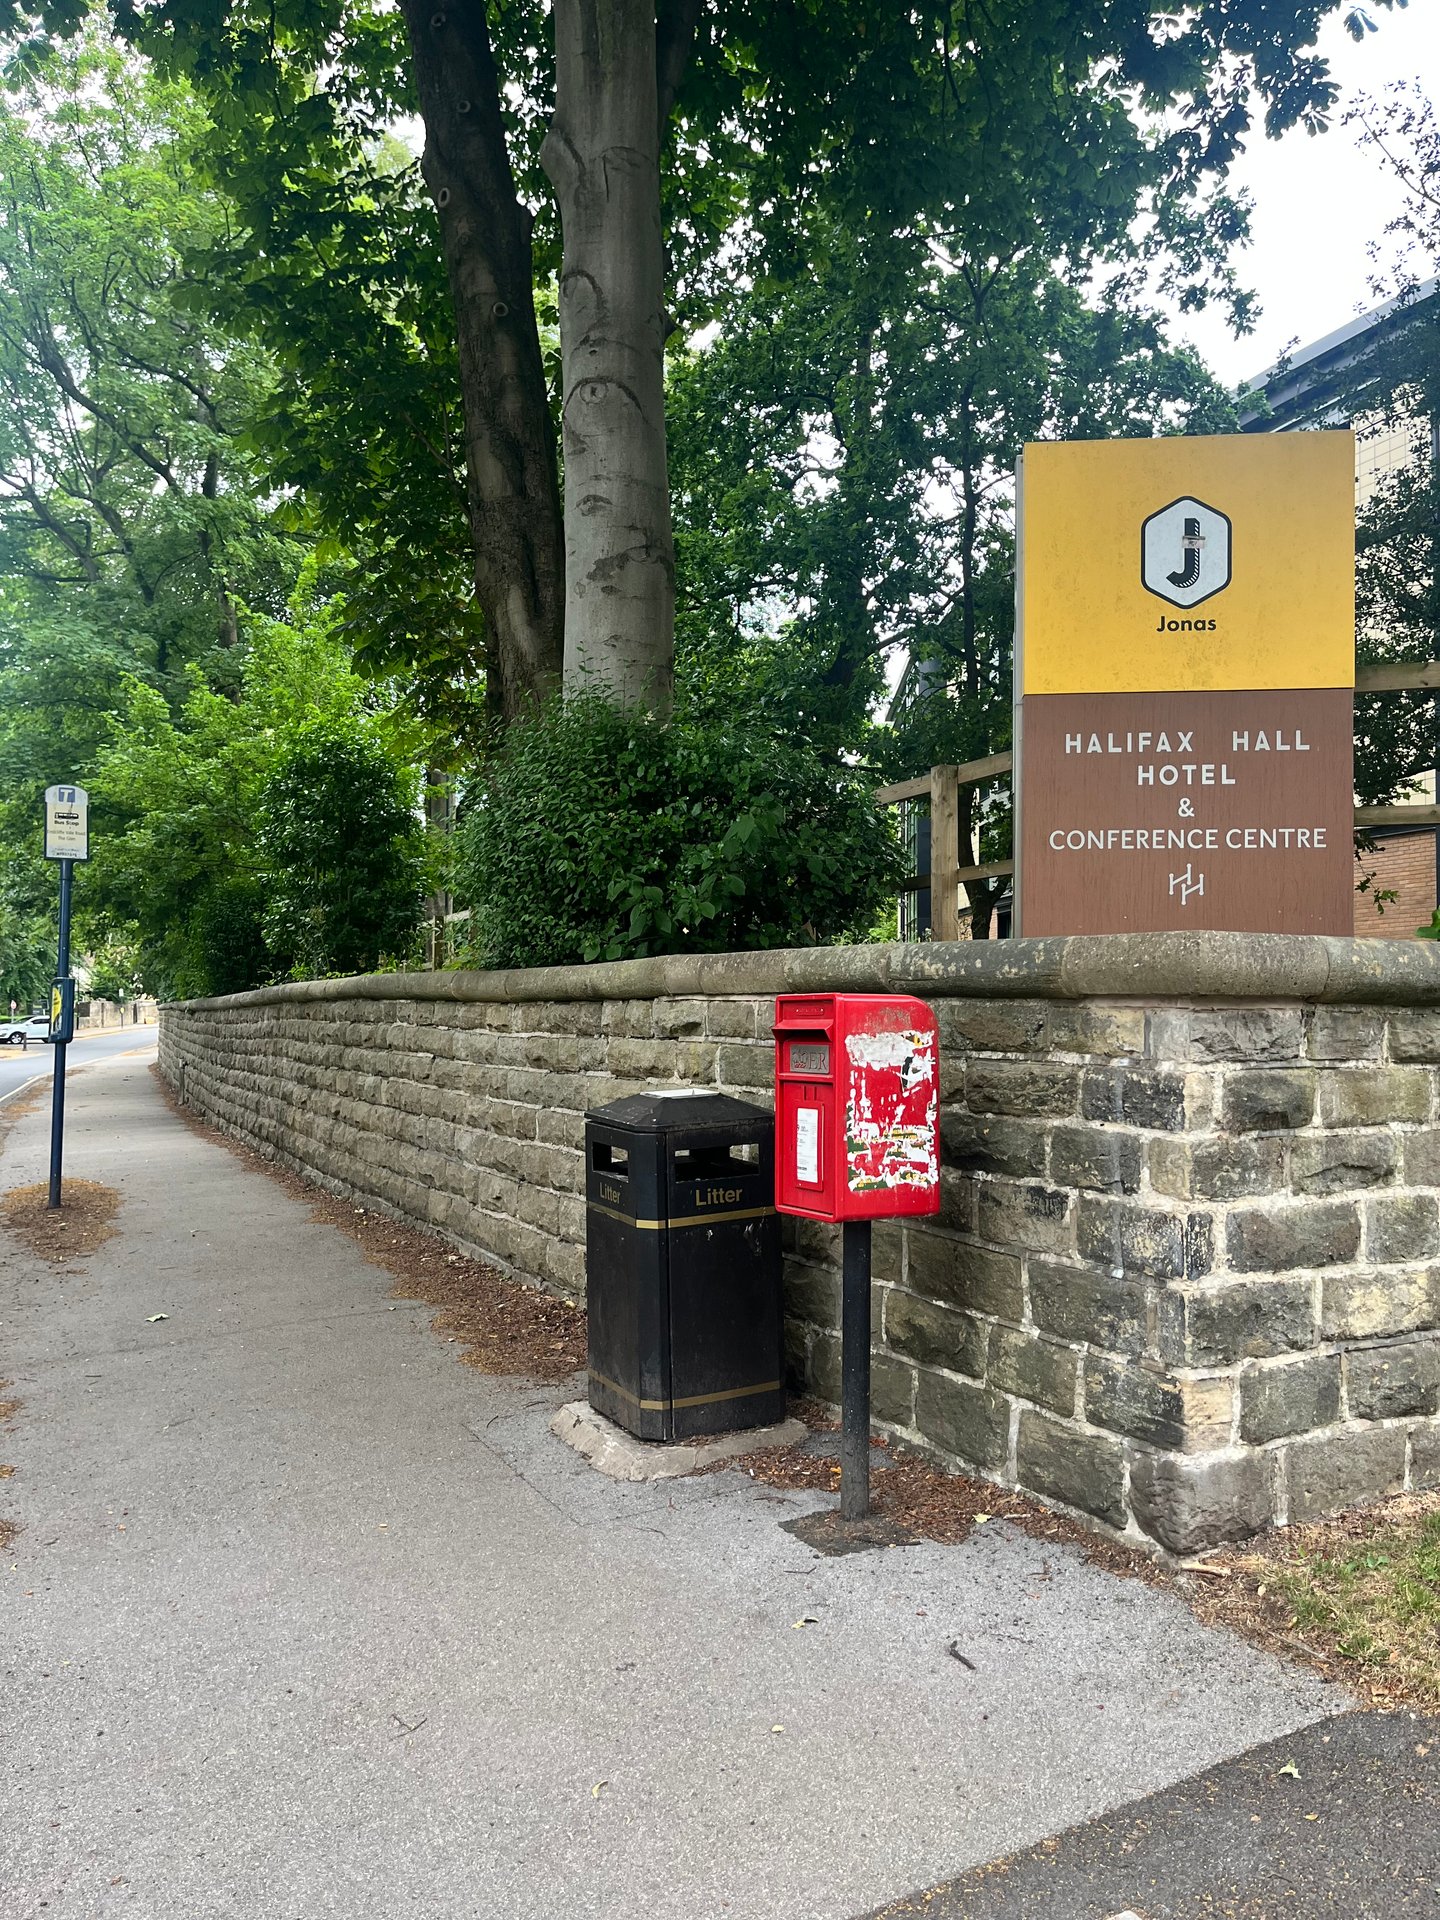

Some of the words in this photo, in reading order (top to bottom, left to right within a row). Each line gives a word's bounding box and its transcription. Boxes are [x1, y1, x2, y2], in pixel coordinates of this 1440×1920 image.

[1166, 518, 1200, 588] J
[1156, 616, 1217, 632] Jonas
[1065, 731, 1194, 754] HALIFAX
[1232, 730, 1311, 751] HALL
[1137, 764, 1236, 786] HOTEL
[1177, 797, 1195, 817] &
[1049, 829, 1219, 850] CONFERENCE
[1225, 828, 1327, 849] CENTRE
[600, 1182, 621, 1203] Litter
[695, 1188, 743, 1206] Litter
